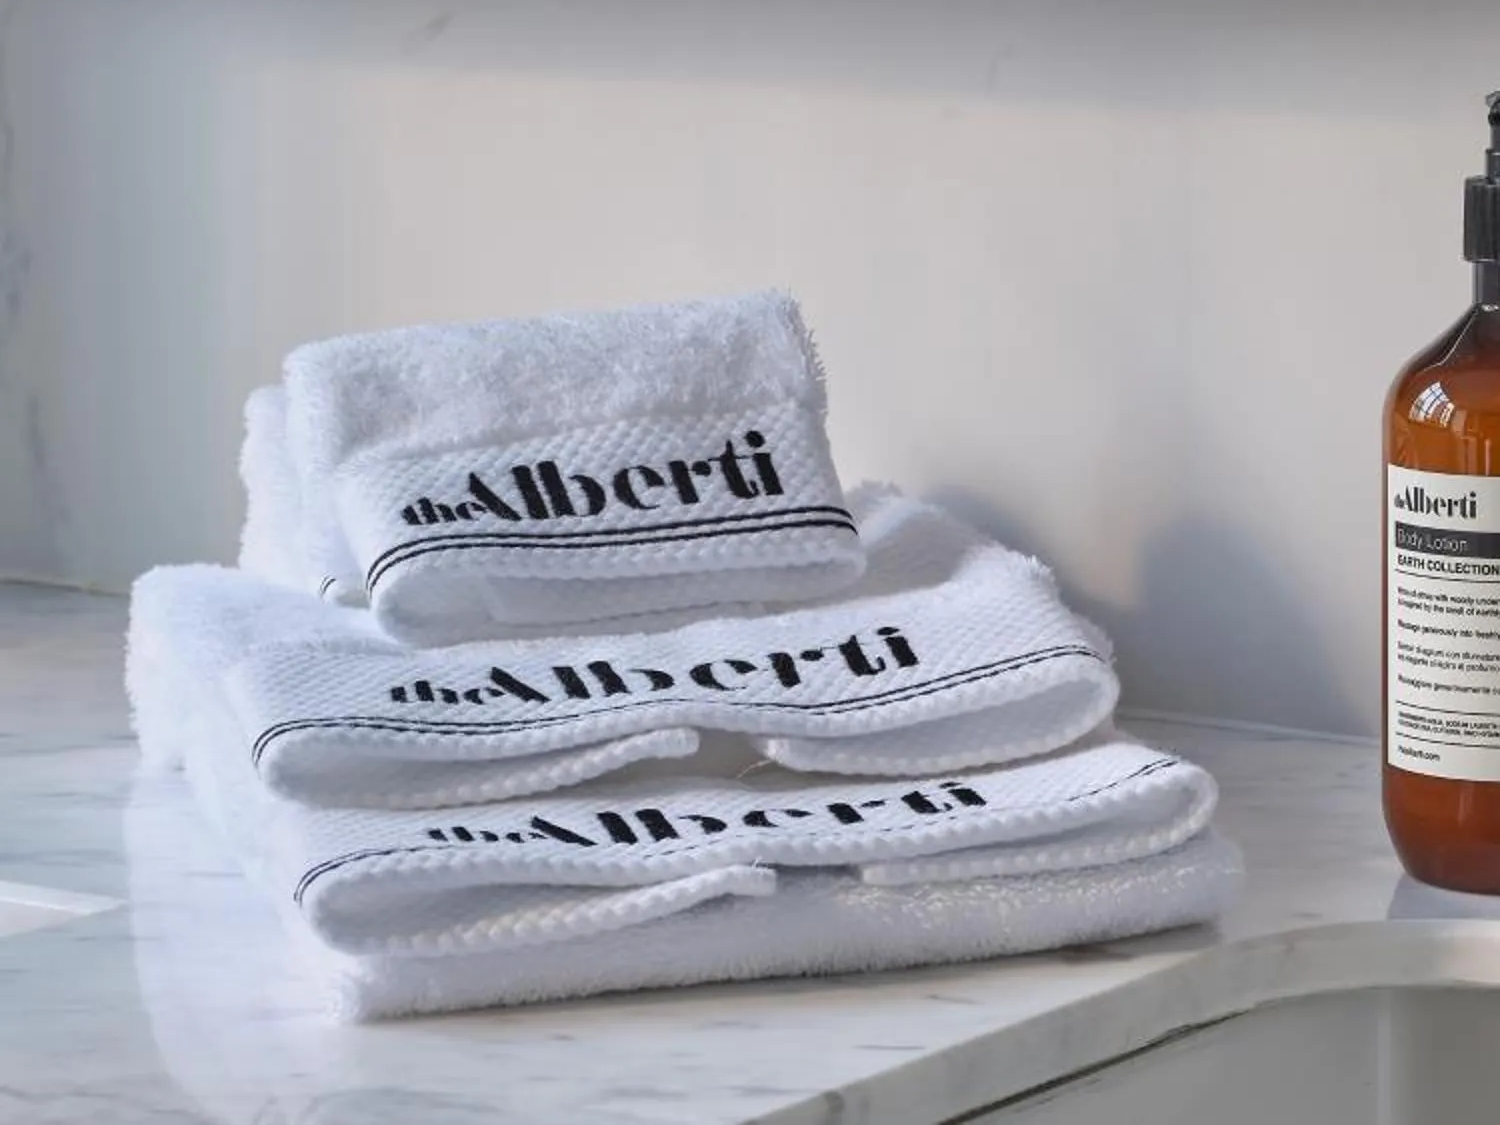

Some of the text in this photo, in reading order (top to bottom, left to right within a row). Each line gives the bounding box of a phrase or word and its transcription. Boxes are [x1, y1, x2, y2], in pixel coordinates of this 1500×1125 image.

[401, 430, 786, 526] theAlberti
[1398, 528, 1469, 553] Body Lotion
[1398, 554, 1425, 570] EARTH
[1427, 559, 1500, 576] COLLECTION
[389, 625, 920, 706] theAlberti
